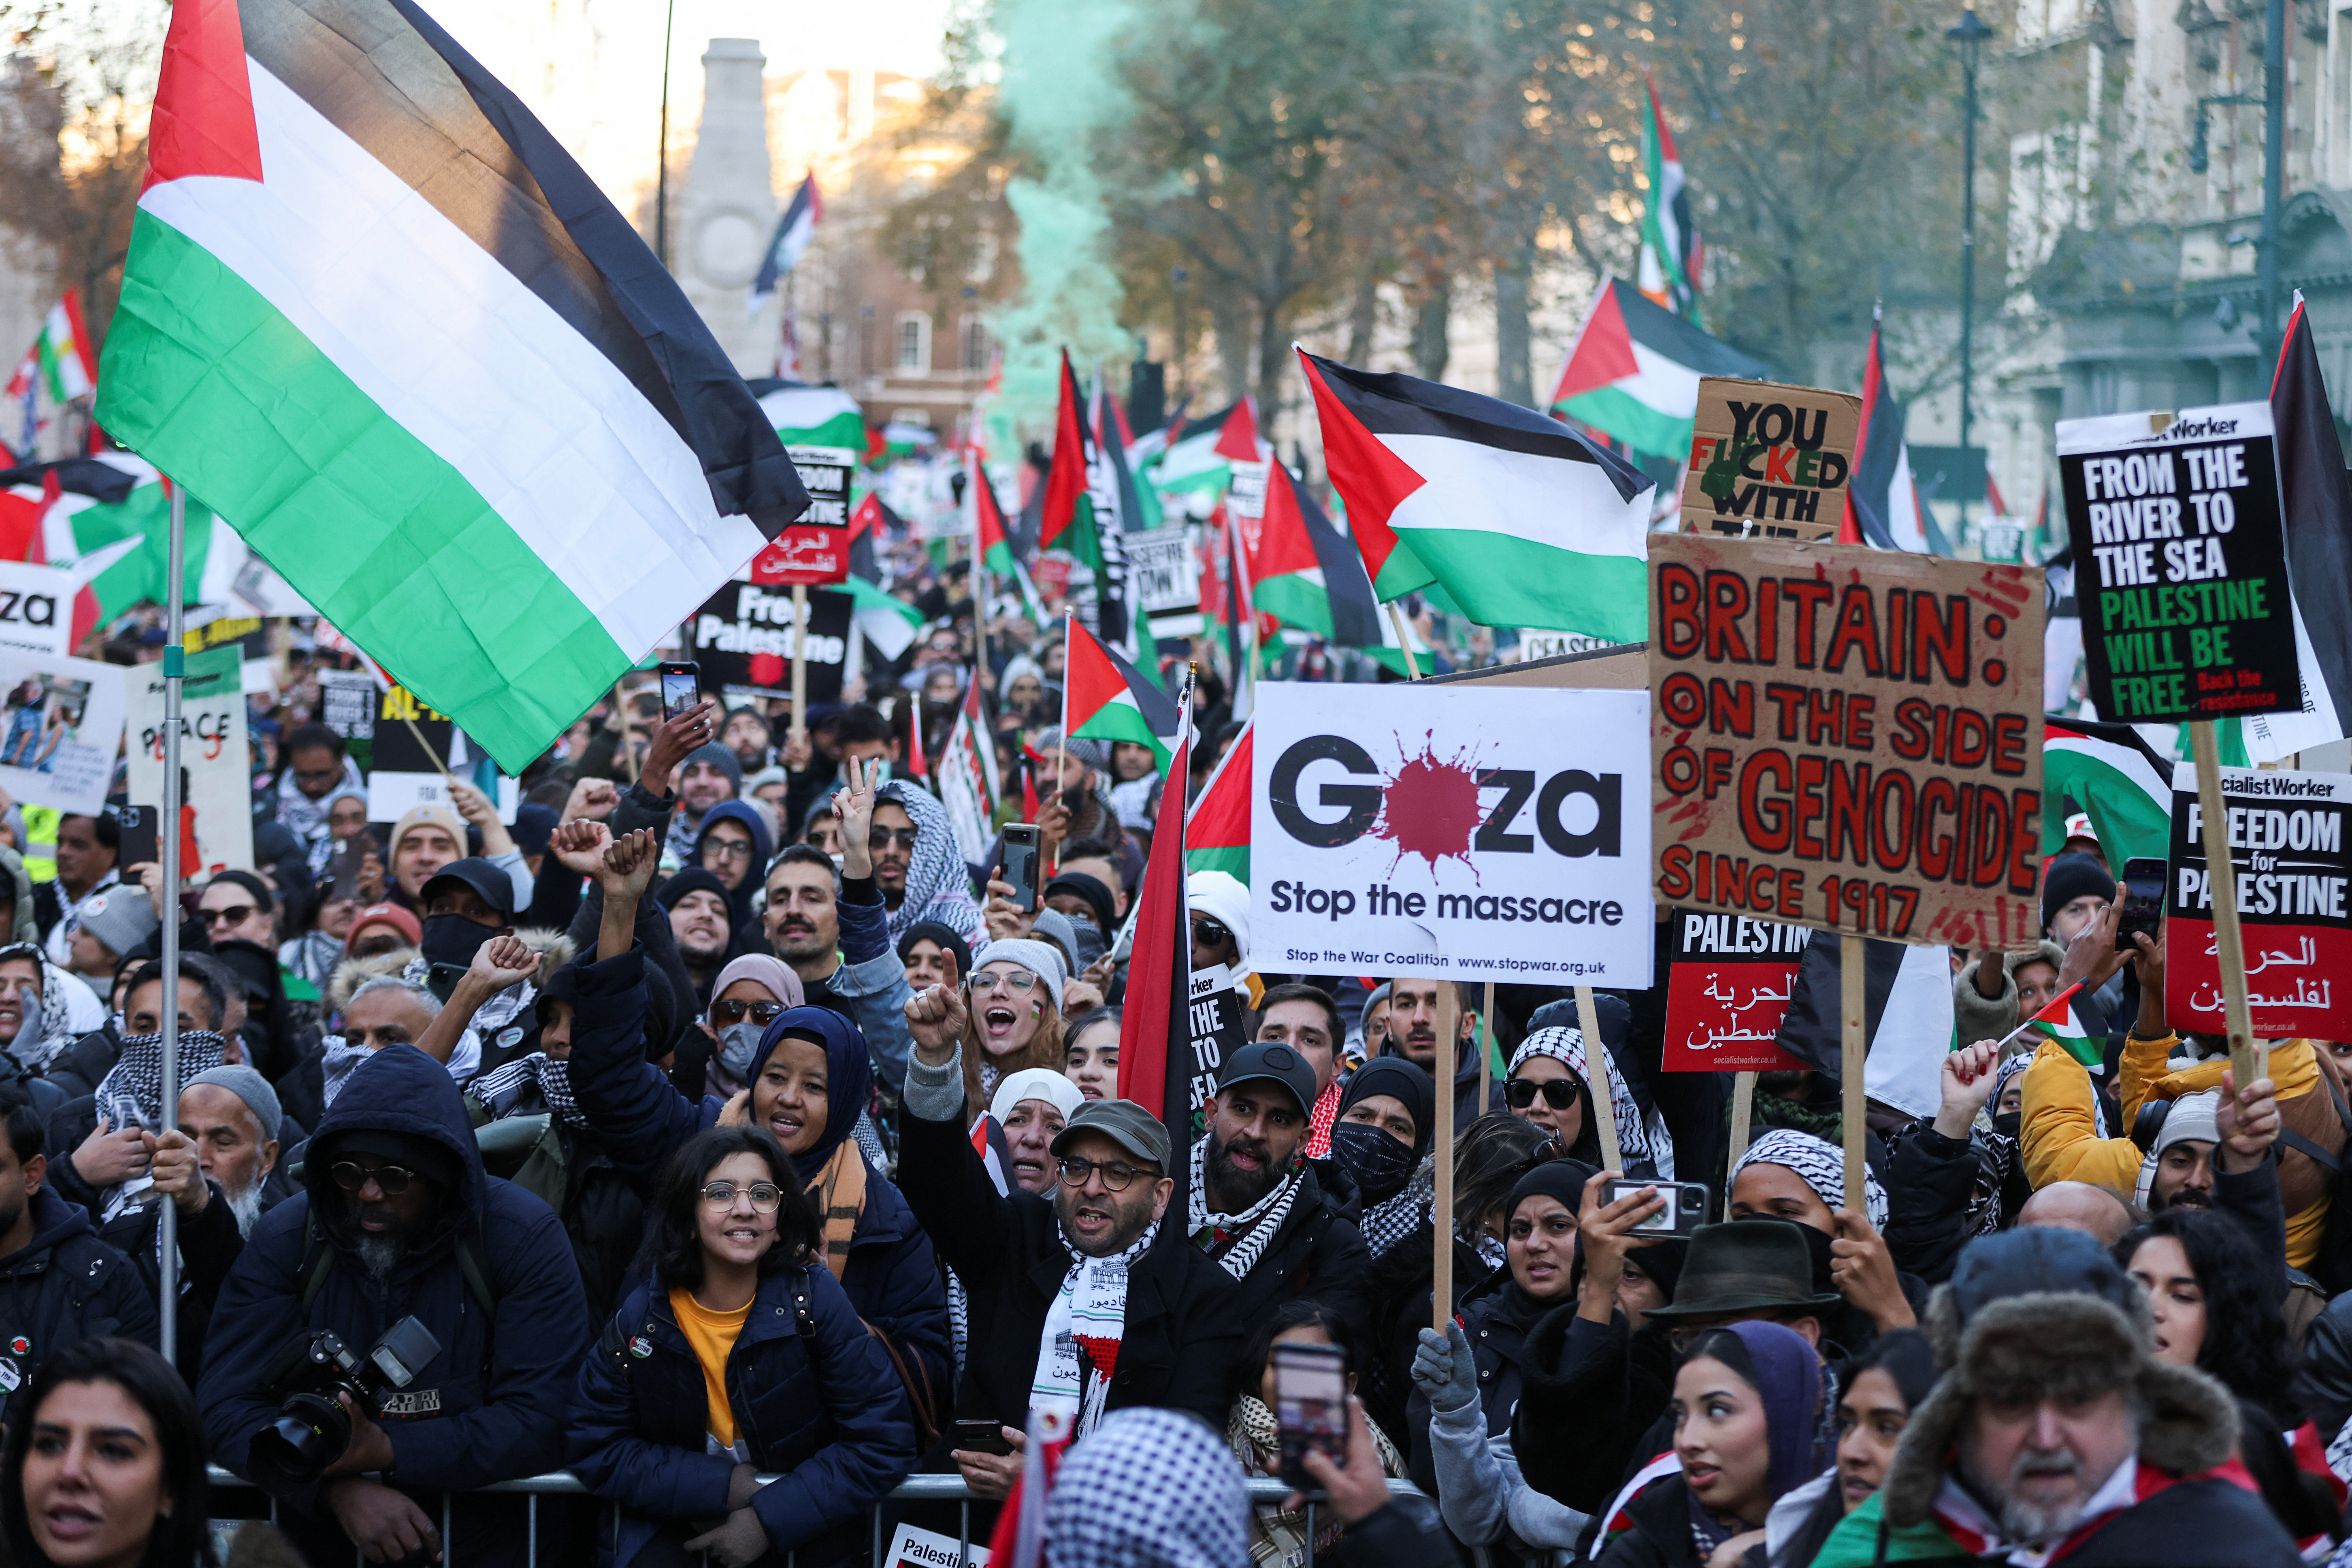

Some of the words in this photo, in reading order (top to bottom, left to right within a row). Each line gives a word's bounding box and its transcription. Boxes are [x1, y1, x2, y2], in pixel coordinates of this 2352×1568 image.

[1726, 401, 1828, 451] YOU
[2170, 417, 2238, 440] Worker
[1689, 437, 1848, 489] FUCKED
[2083, 451, 2177, 500] FROM
[2182, 445, 2249, 491] THE
[1711, 484, 1820, 523] WITH
[2088, 496, 2184, 544] RIVER
[2189, 490, 2236, 534] TO
[2092, 543, 2159, 587] THE
[2163, 537, 2228, 582] SEA
[1657, 563, 2007, 688] BRITAIN:
[2099, 579, 2270, 631] PALESTINE
[695, 597, 845, 665] Palestne
[2103, 631, 2184, 674] WILL
[2189, 626, 2234, 668] BE
[2110, 673, 2190, 717] FREE
[2197, 669, 2235, 690] Back
[2236, 668, 2263, 688] the
[141, 713, 232, 756] PACE
[1660, 672, 1755, 739] ON
[1766, 682, 1876, 752] THE
[1890, 697, 2028, 778] SIDE
[1269, 734, 1623, 859] Gza
[2271, 778, 2334, 797] Worker
[1662, 745, 1733, 799] OF
[1737, 748, 2040, 895] GENOCIDE
[2188, 802, 2341, 853] FEEDOM
[2250, 850, 2277, 871] for
[1271, 880, 1356, 921] Stop
[1367, 884, 1427, 917] the
[1438, 893, 1624, 926] massacre
[1657, 844, 1805, 918] SINCE
[1818, 874, 1920, 937] 1917
[2178, 867, 2348, 918] PAESTINE
[1286, 949, 1319, 963] Stop
[1323, 950, 1346, 962] the
[1351, 951, 1379, 964] War
[1384, 952, 1449, 967] Coalition
[1458, 958, 1606, 975] www.stopwar.org.uk
[2204, 931, 2316, 975] الحرة
[1190, 998, 1225, 1038] THE
[1191, 1036, 1221, 1072] TO
[1713, 1055, 1777, 1065] socialistworker.co.uk
[1363, 1132, 1393, 1149] INTERNATIONAL
[902, 1538, 977, 1568] Palestie
